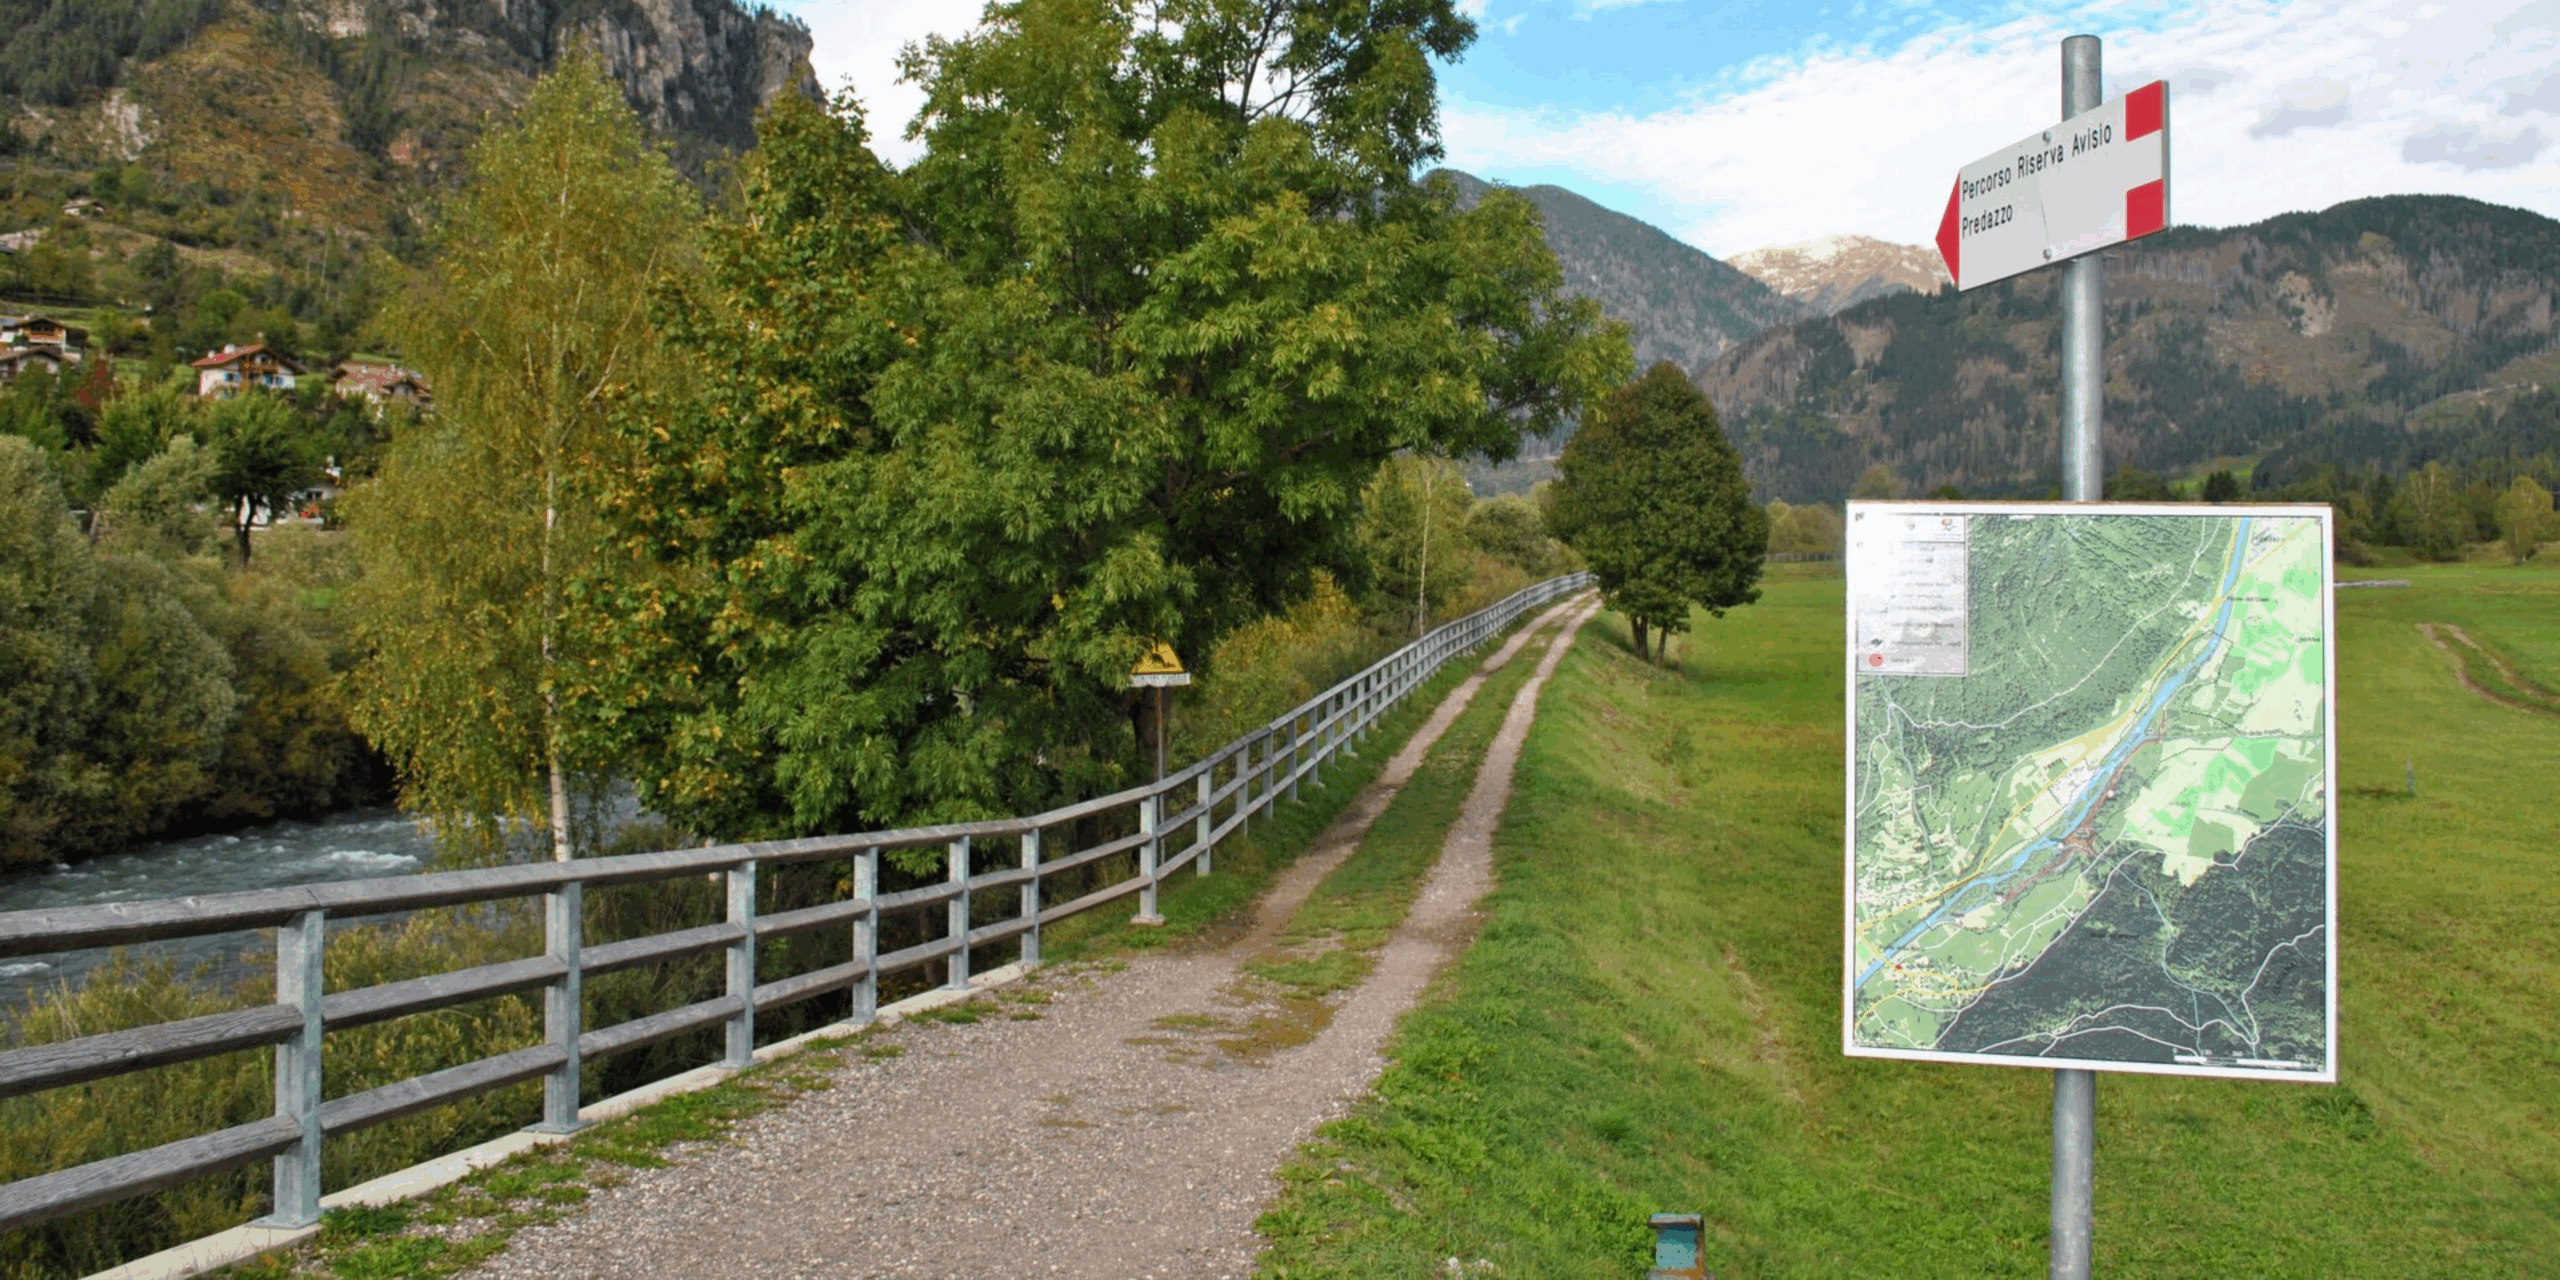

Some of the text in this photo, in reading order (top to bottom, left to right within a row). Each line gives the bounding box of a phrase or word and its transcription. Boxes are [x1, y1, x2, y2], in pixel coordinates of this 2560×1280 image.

[1962, 122, 2112, 202] Percorso Riserva Avisio
[1962, 204, 2013, 239] Predazzo
